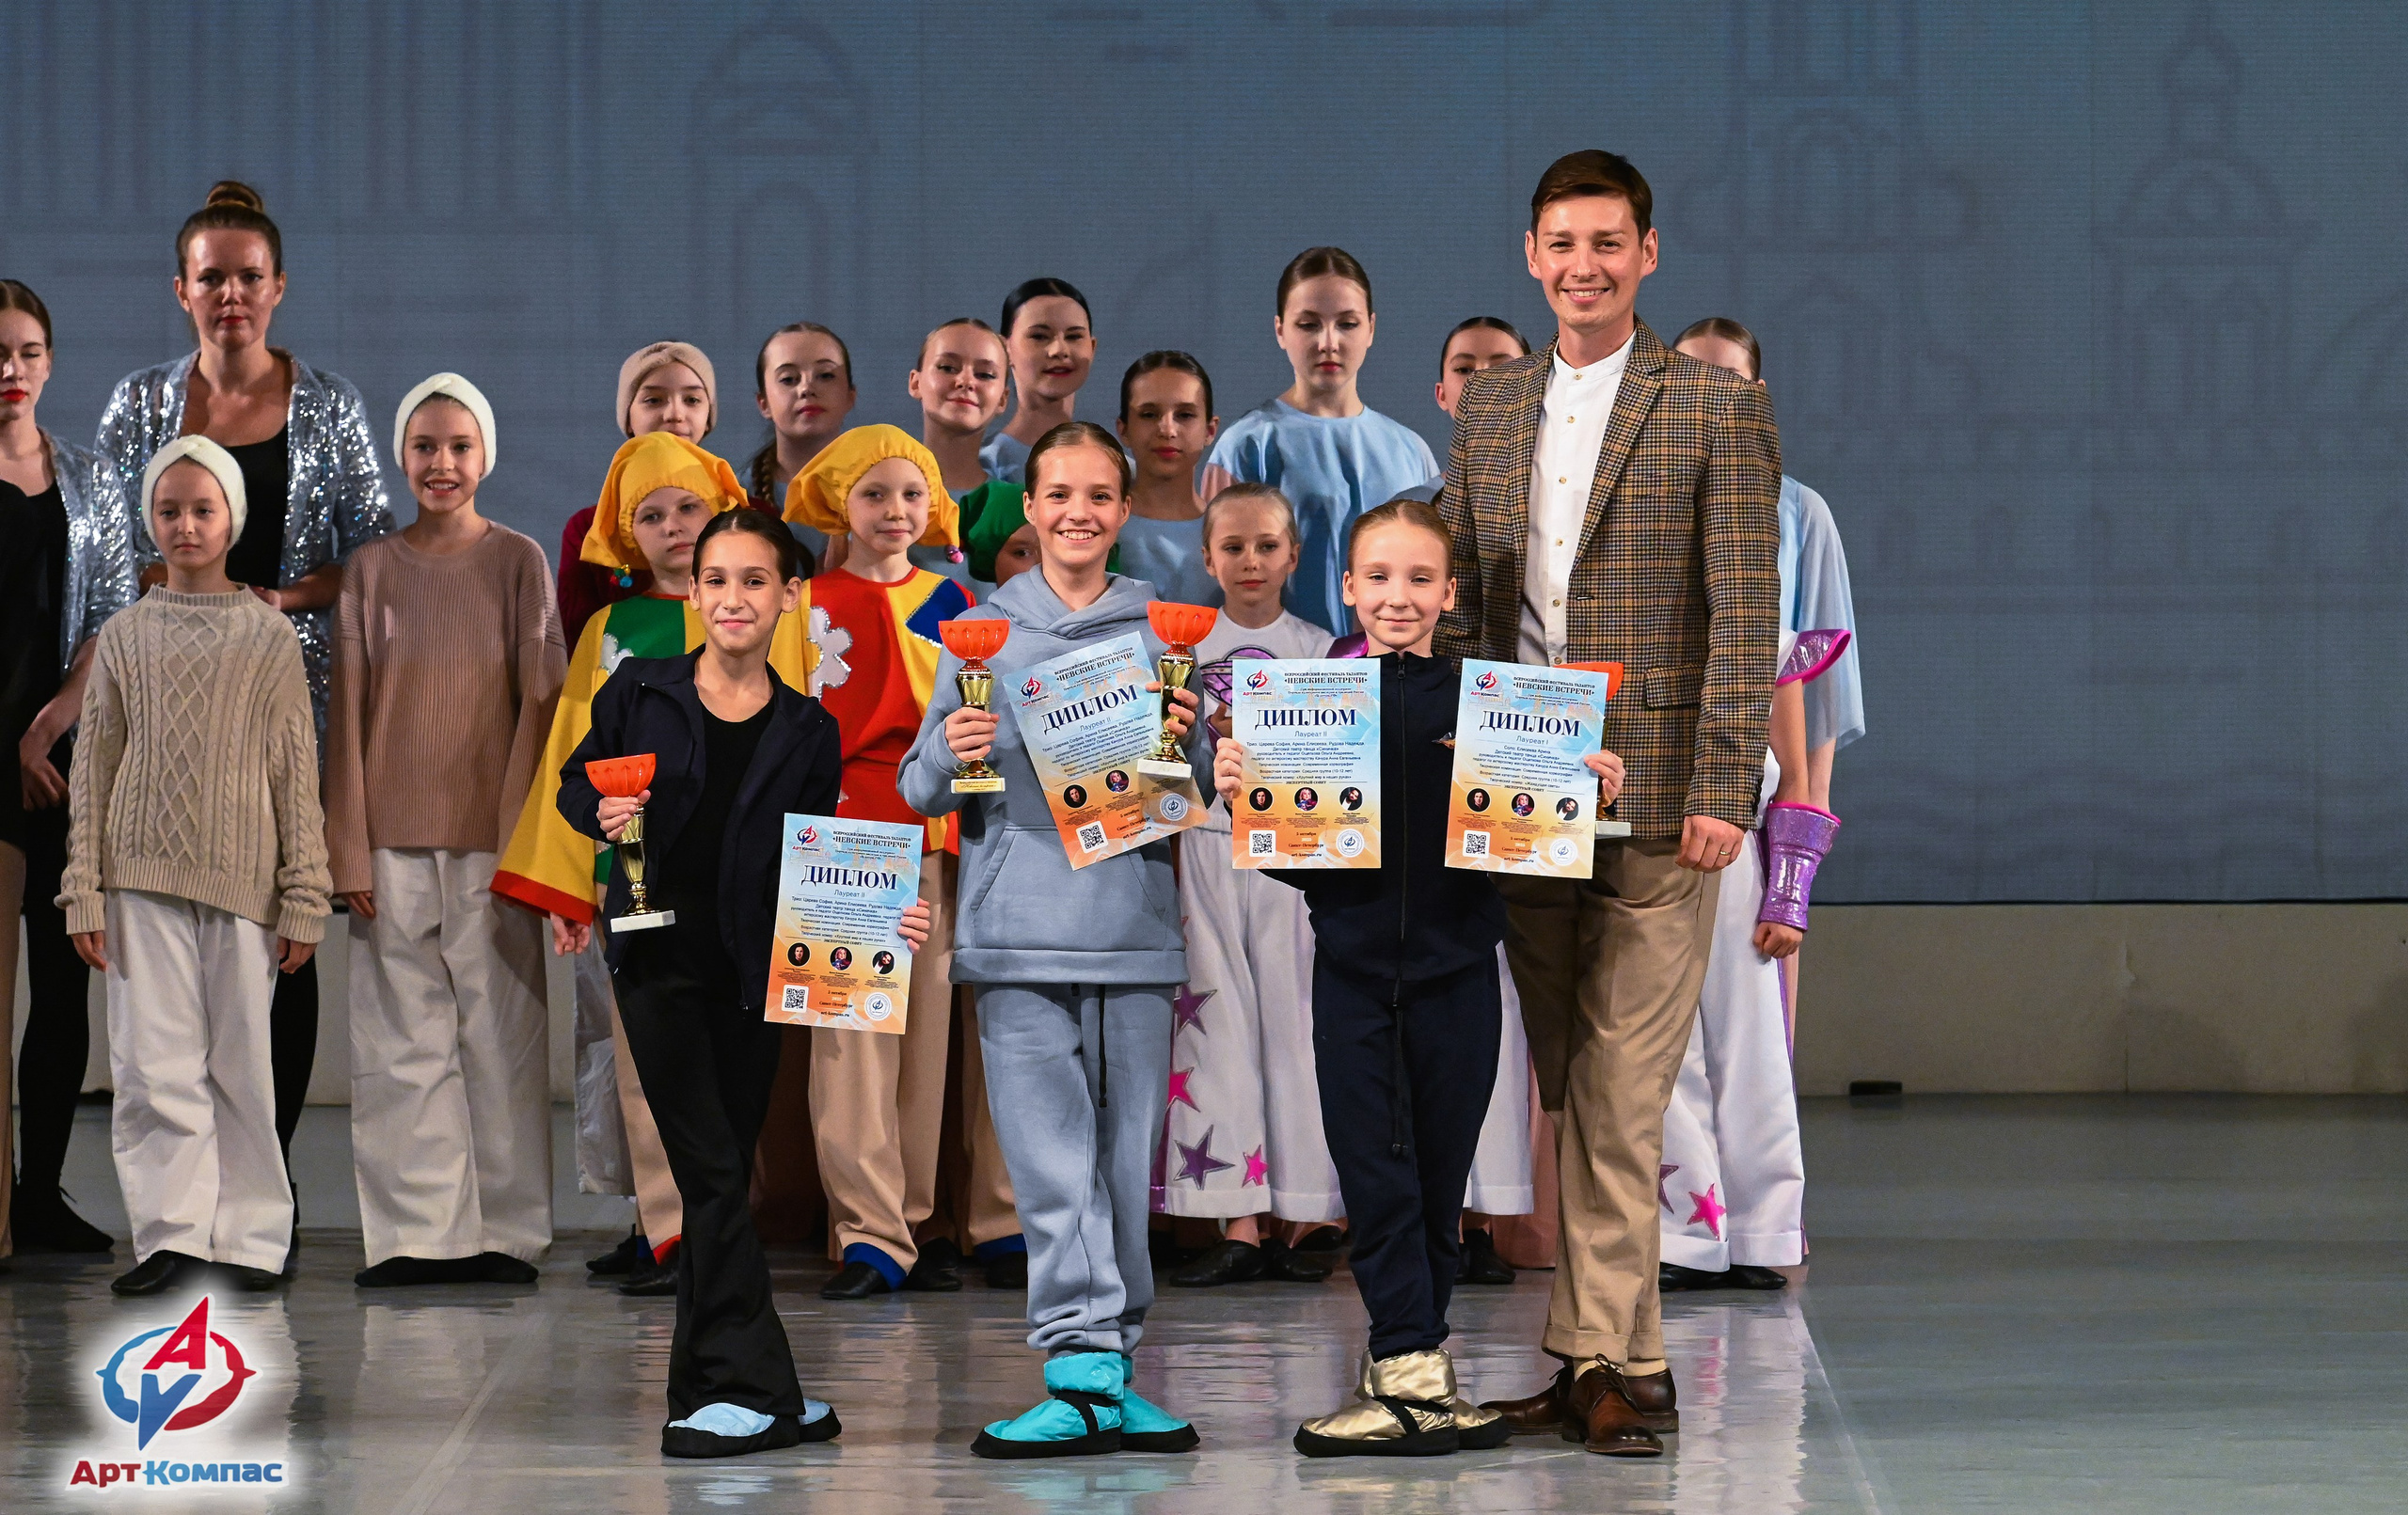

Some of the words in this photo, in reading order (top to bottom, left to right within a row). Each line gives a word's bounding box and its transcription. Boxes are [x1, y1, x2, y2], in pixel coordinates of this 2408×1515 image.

[1040, 685, 1139, 735] ДИПЛОМ
[1254, 709, 1357, 730] ДИПЛОМ
[1079, 718, 1107, 732] Лауреат
[1479, 710, 1581, 737] ДИПЛОМ
[1516, 735, 1544, 745] Лауреат
[801, 865, 898, 890] ДИПЛОМ
[834, 890, 860, 898] Лауреат
